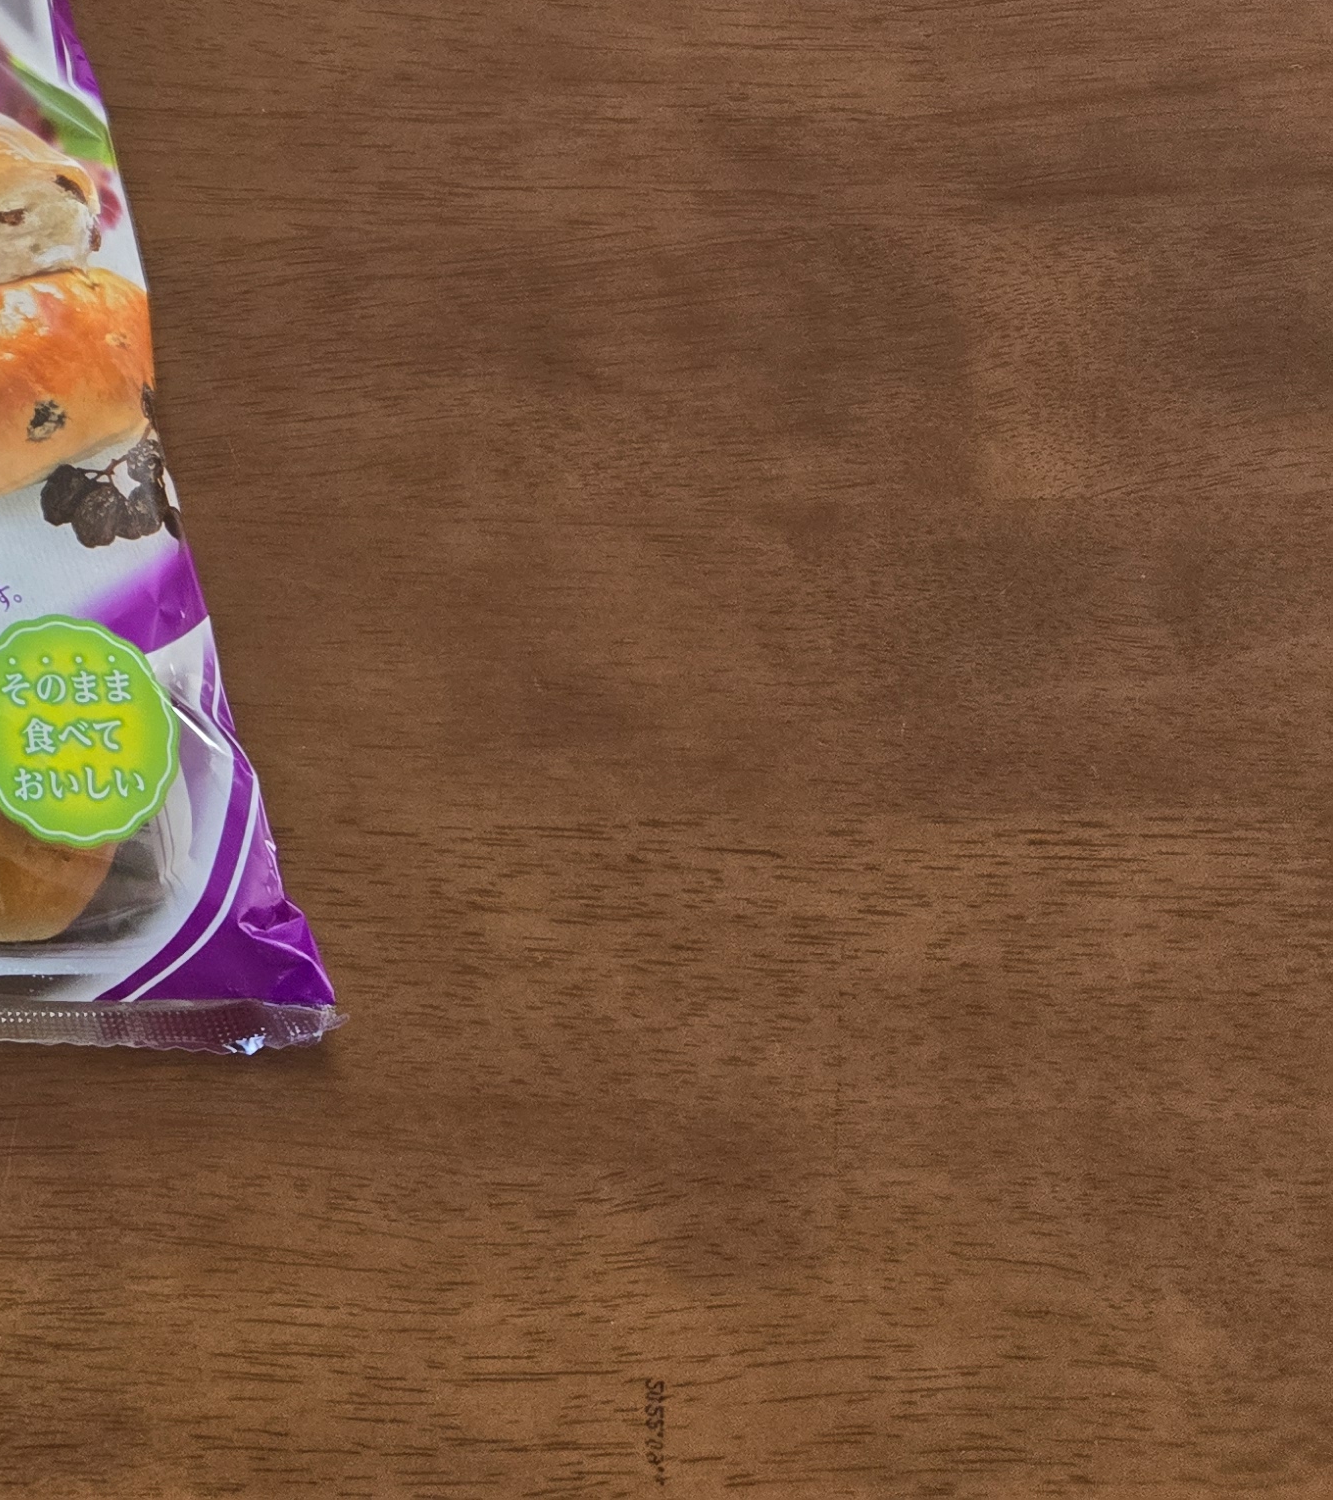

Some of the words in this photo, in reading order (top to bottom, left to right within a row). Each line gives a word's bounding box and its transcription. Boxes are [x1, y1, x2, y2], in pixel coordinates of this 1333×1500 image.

[0, 668, 133, 705] そのまま
[22, 717, 124, 756] 食べて
[13, 766, 147, 801] おいしい
